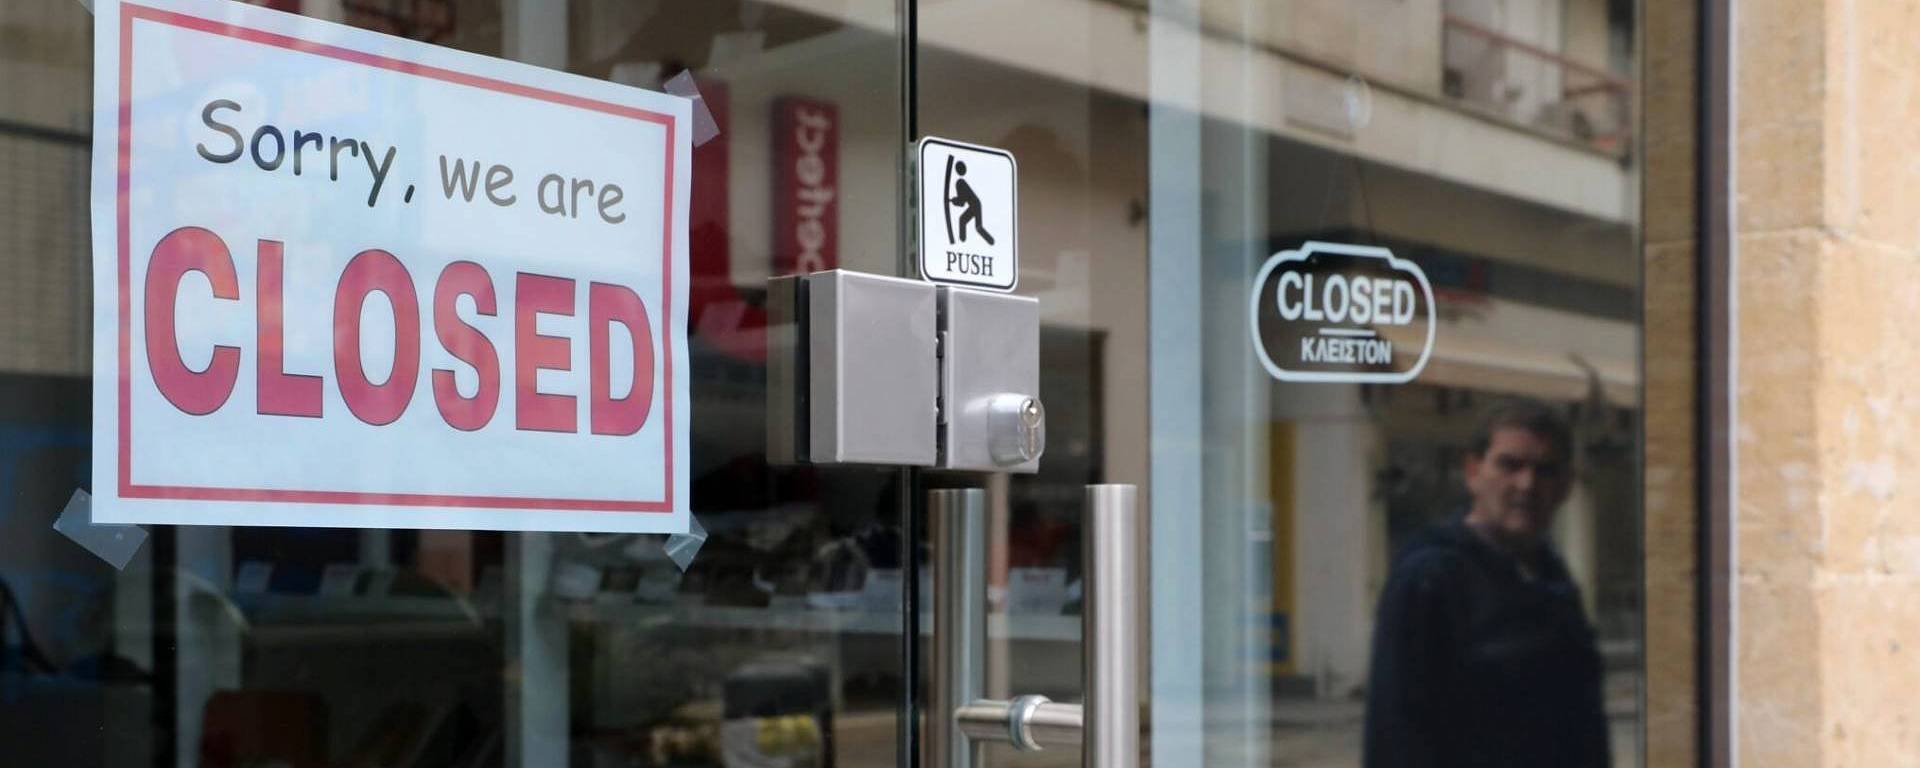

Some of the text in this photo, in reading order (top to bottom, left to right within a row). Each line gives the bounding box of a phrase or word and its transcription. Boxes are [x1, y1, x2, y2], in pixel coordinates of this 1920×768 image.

[196, 99, 626, 224] Sorry, we are
[946, 251, 993, 276] PUSH
[1277, 270, 1415, 325] CLOSED
[144, 226, 655, 437] CLOSED
[1301, 336, 1391, 364] ΚΛΕΙΣΤΟΝ
